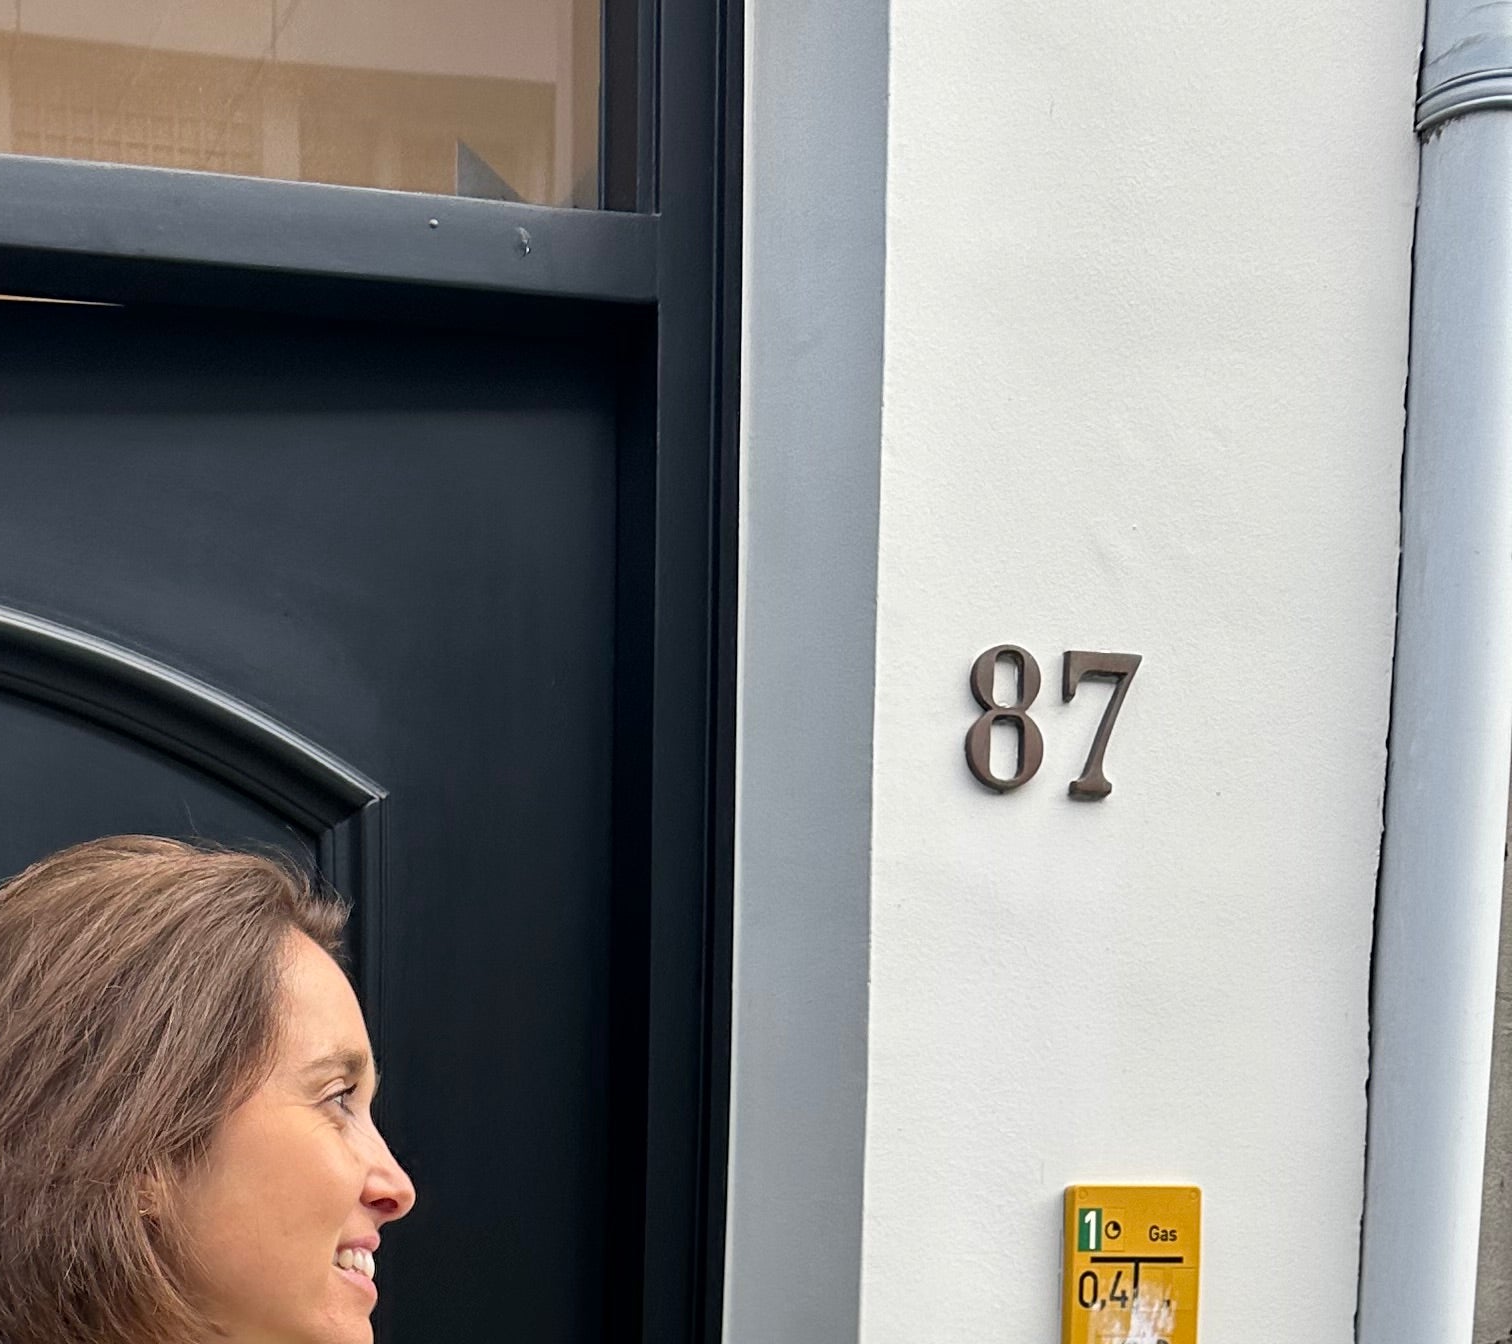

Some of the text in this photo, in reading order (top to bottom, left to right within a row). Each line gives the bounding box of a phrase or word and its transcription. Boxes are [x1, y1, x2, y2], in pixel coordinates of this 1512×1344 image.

[964, 644, 1143, 801] 87
[1084, 1210, 1178, 1250] 1 Gas
